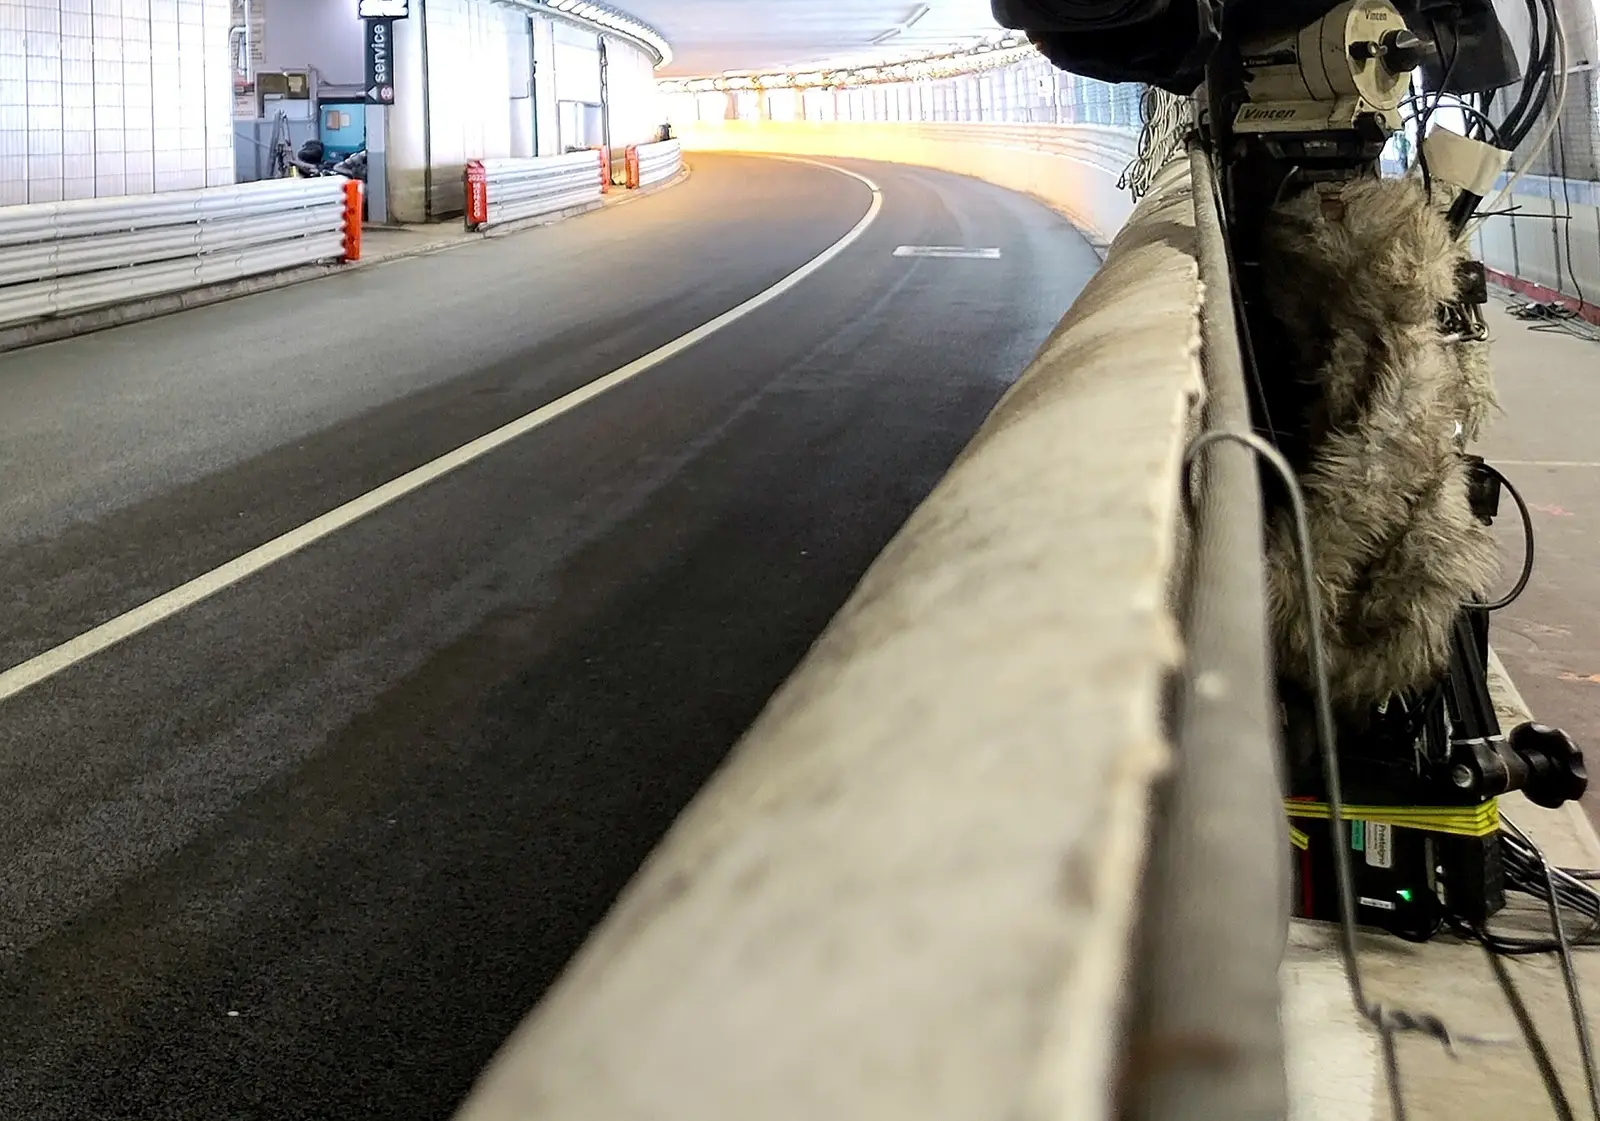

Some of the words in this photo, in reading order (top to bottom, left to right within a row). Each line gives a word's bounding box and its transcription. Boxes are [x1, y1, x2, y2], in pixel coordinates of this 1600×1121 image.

[1364, 9, 1388, 22] Vinten
[371, 24, 386, 83] service
[1243, 108, 1296, 120] Vinten
